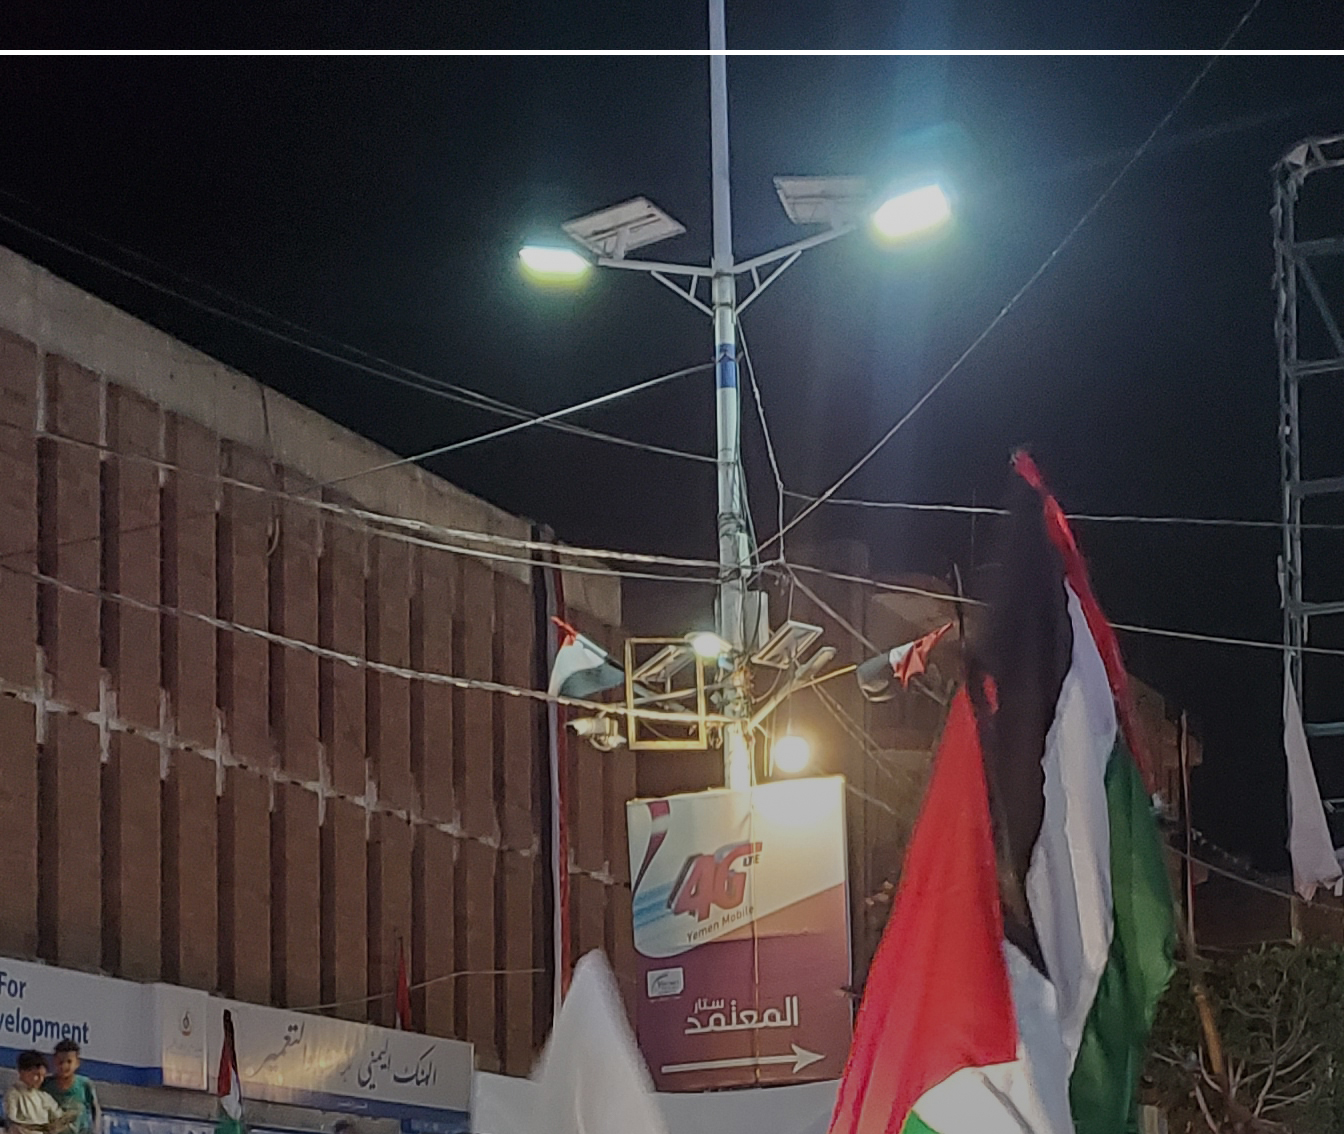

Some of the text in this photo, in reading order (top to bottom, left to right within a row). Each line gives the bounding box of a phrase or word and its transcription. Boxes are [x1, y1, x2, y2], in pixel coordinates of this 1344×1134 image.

[666, 841, 763, 922] 4G
[687, 905, 754, 942] Yemen Mobile
[684, 996, 799, 1035] المعتمد
